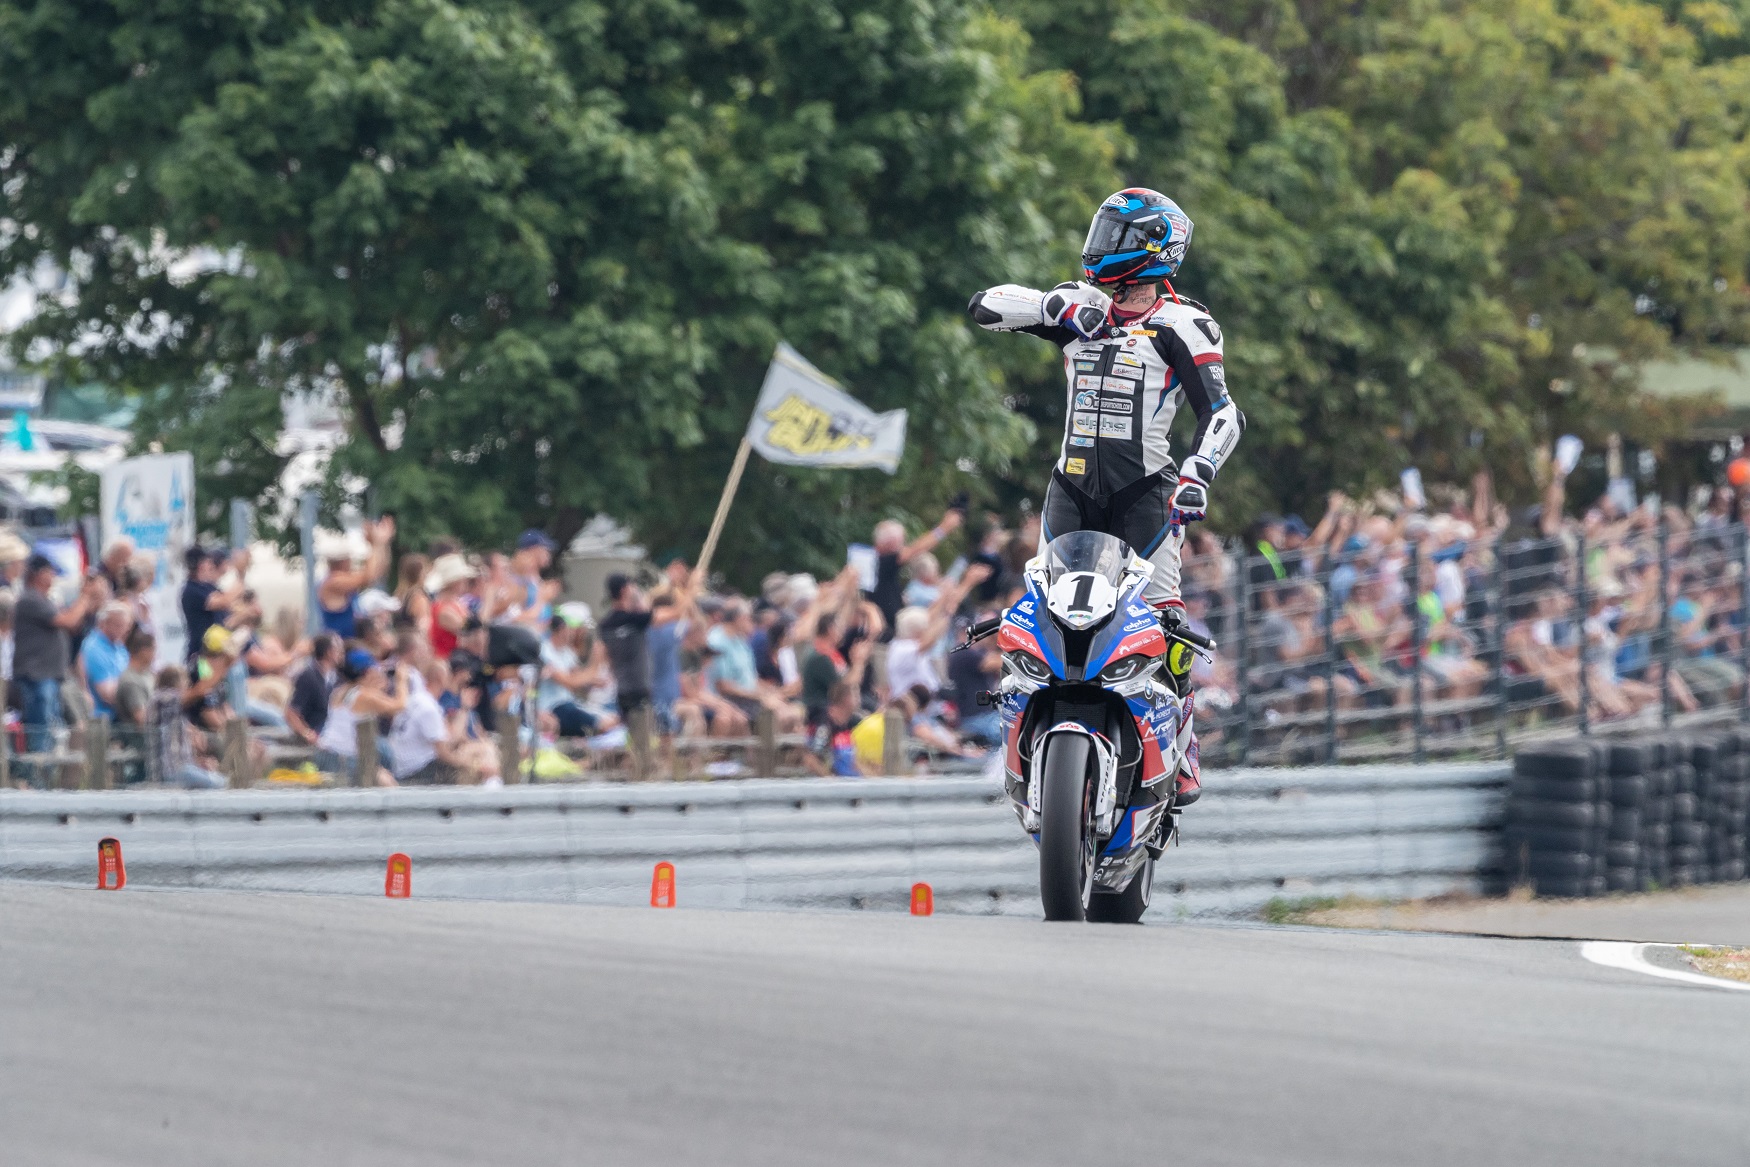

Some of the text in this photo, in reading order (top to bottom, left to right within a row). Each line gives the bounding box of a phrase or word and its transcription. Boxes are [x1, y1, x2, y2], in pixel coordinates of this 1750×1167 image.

[1076, 415, 1126, 430] alpha
[1067, 574, 1095, 613] 1
[1013, 614, 1035, 628] alpha
[1126, 617, 1151, 630] alpha
